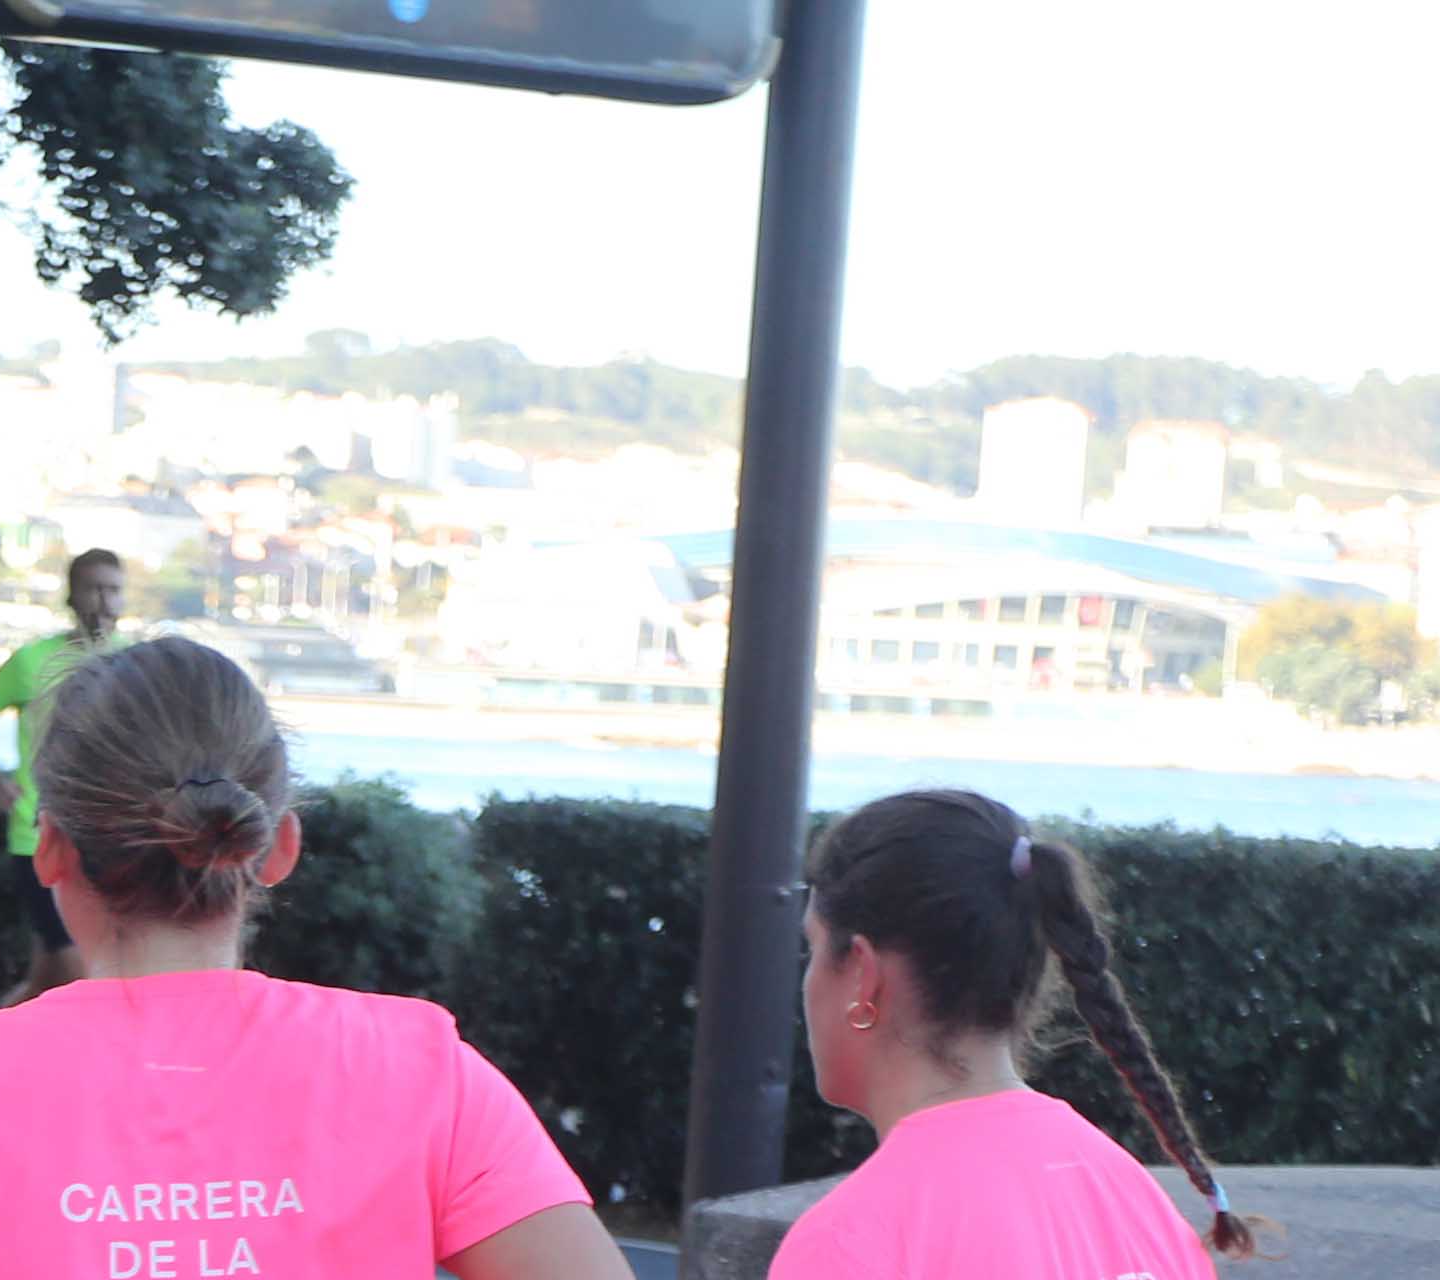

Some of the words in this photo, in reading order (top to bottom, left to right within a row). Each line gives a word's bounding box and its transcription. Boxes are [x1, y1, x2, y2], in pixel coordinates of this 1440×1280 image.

[59, 1177, 305, 1223] CARRERA
[108, 1240, 177, 1280] DE
[198, 1237, 260, 1278] LA
